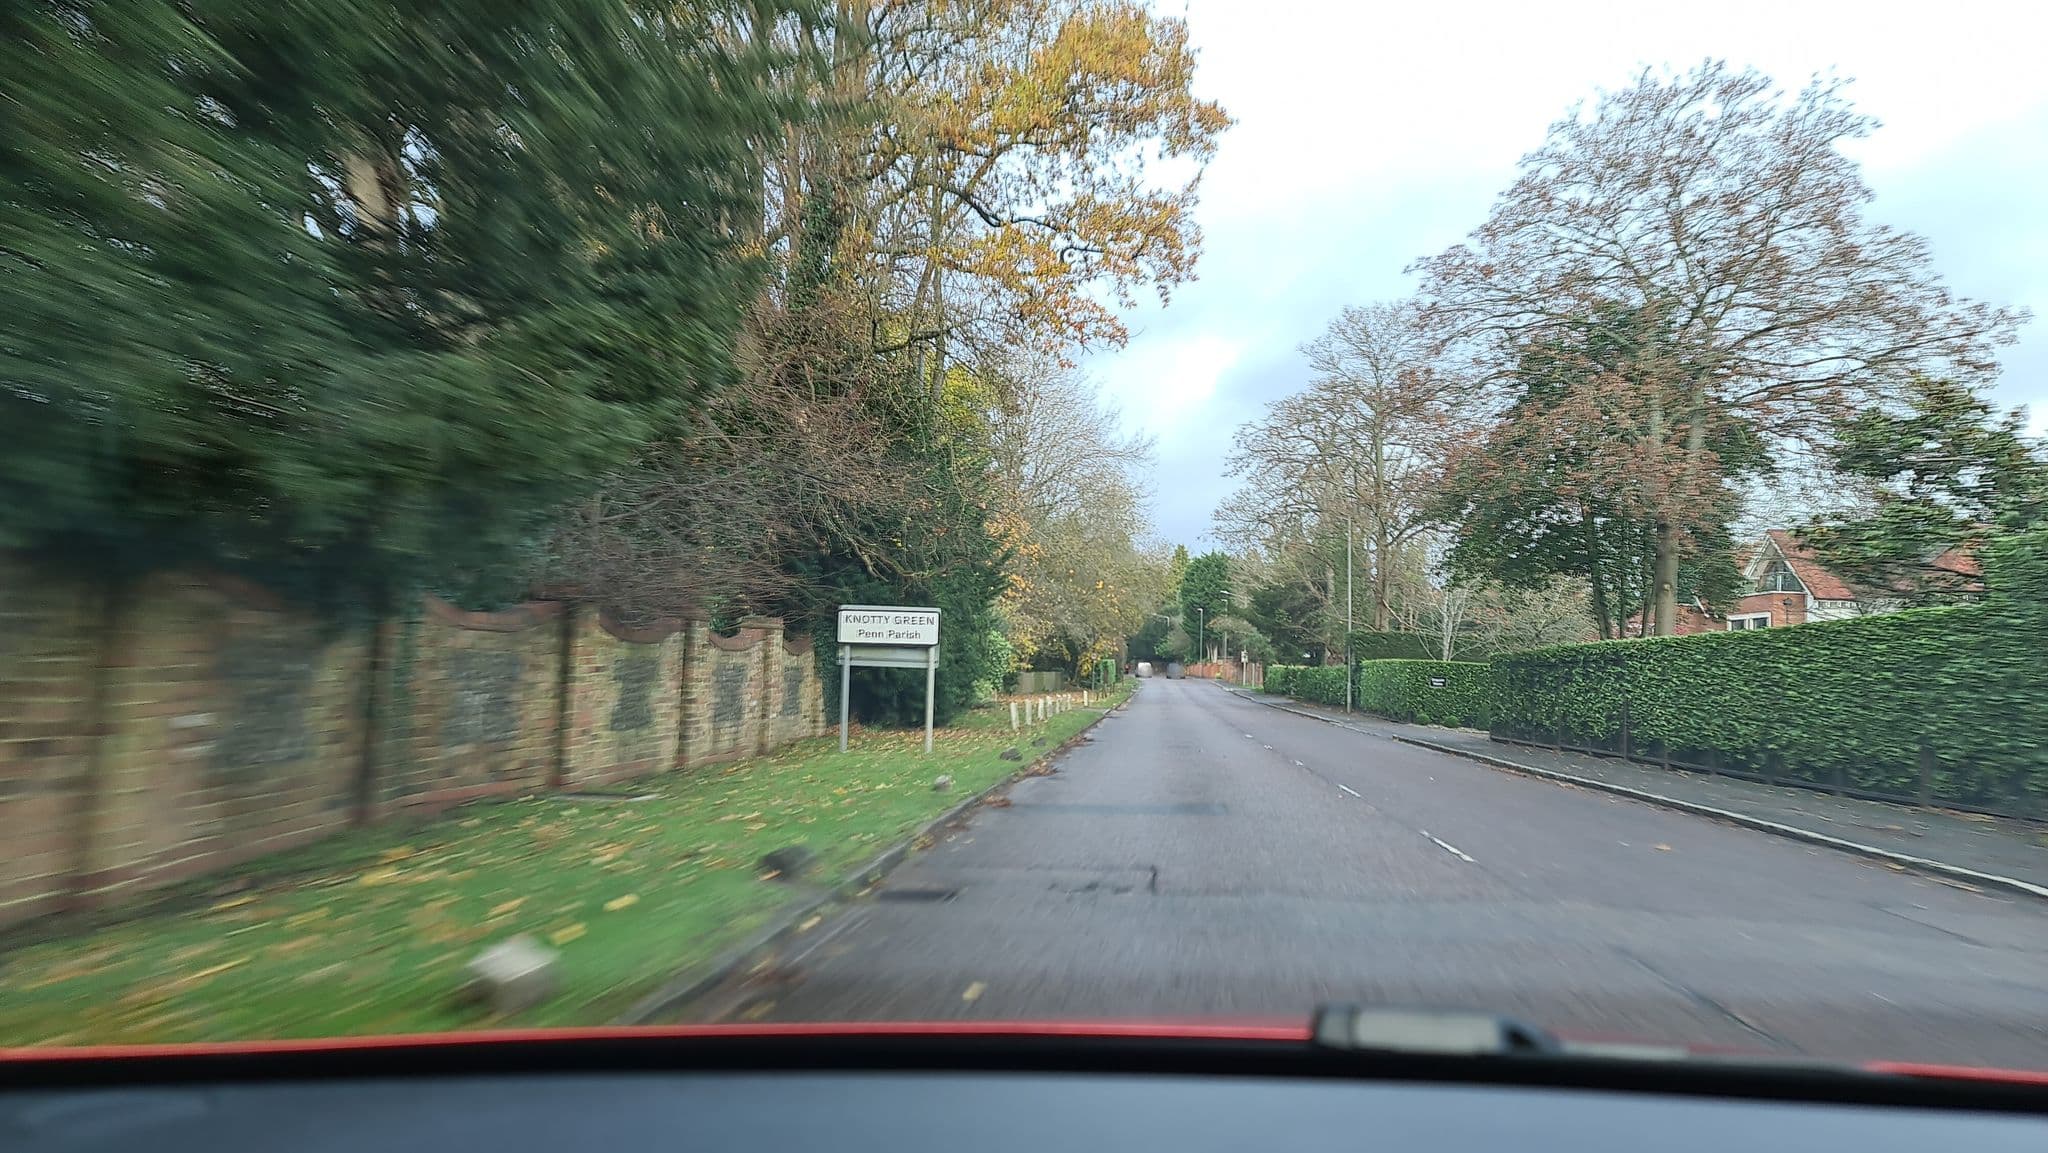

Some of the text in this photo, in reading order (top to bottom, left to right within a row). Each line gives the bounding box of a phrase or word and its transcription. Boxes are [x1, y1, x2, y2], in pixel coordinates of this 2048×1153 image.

[845, 614, 935, 625] KNOTTY GREEN
[858, 629, 921, 639] Penn Parish
